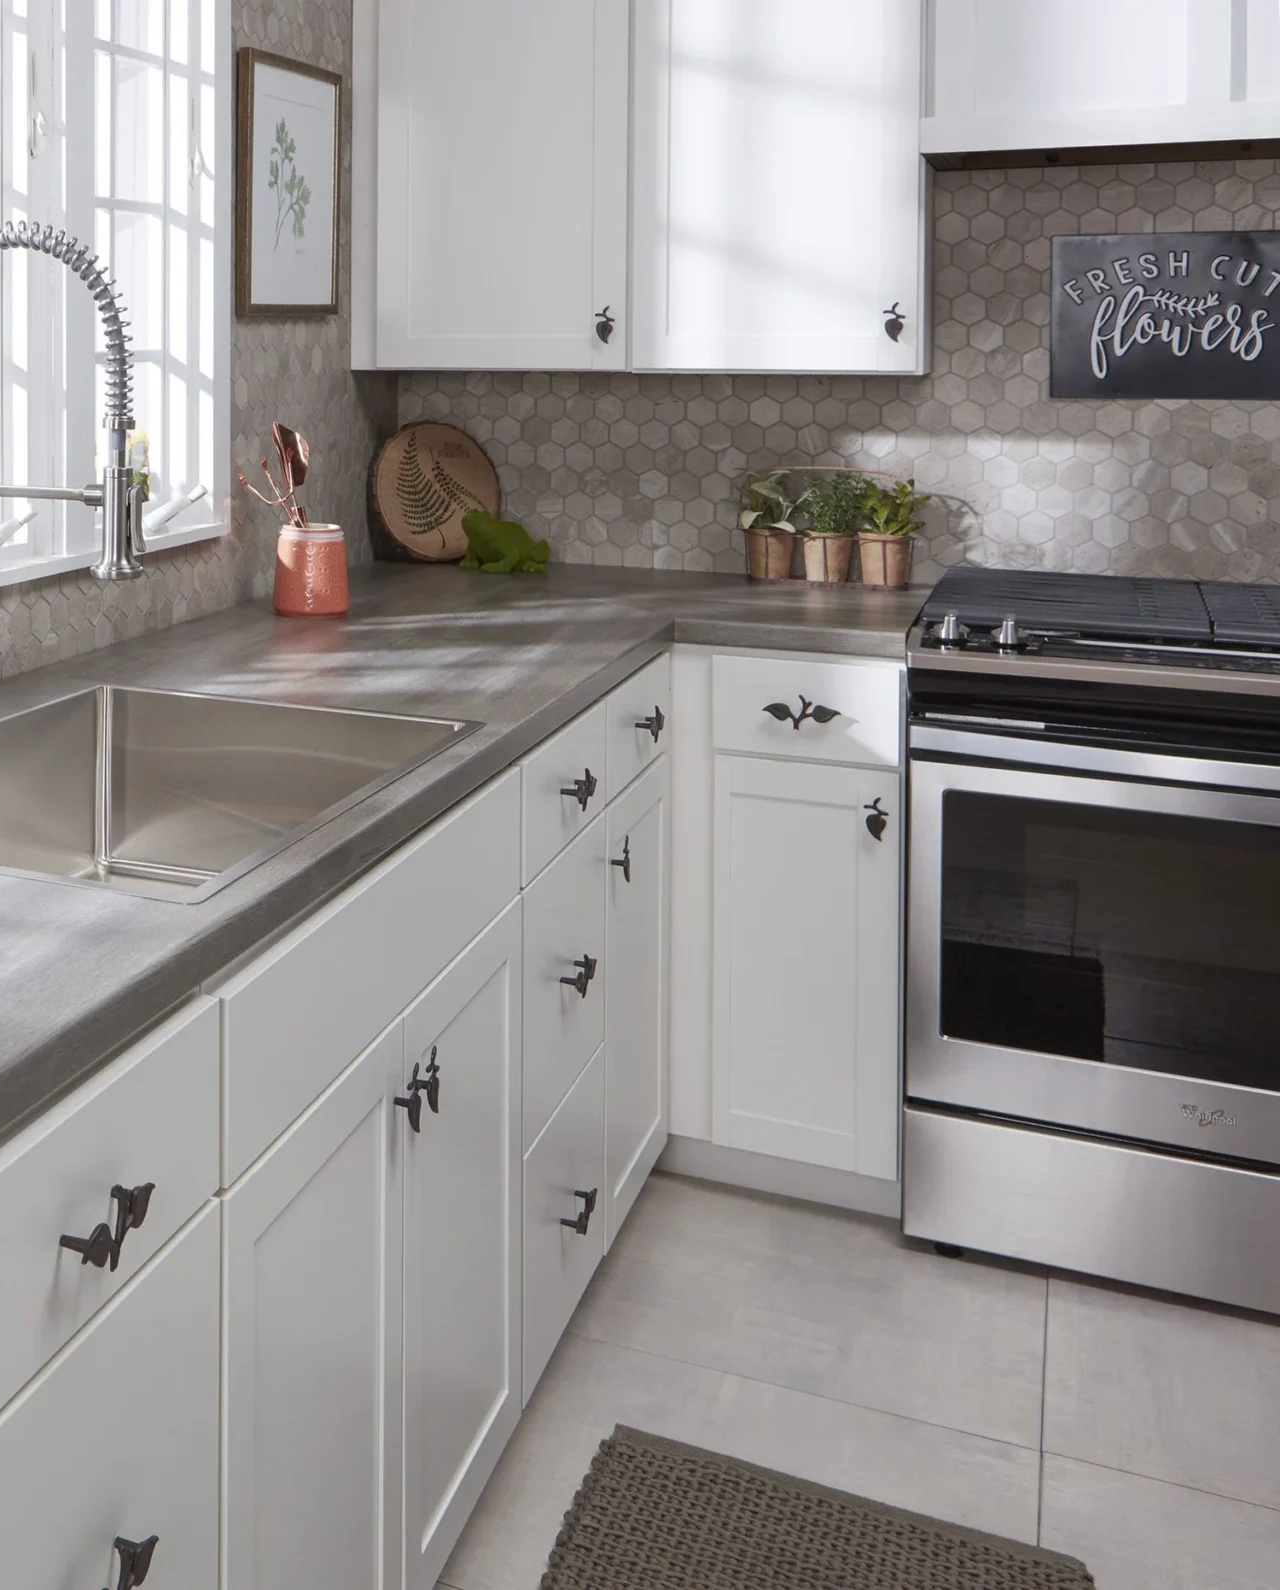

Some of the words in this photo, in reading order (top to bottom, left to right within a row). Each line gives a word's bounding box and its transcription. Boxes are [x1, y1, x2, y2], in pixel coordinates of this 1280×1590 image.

[1063, 250, 1189, 305] FRESH
[1210, 255, 1280, 297] CUT
[1090, 284, 1275, 379] flowers
[1181, 1106, 1236, 1126] Whirlpool
